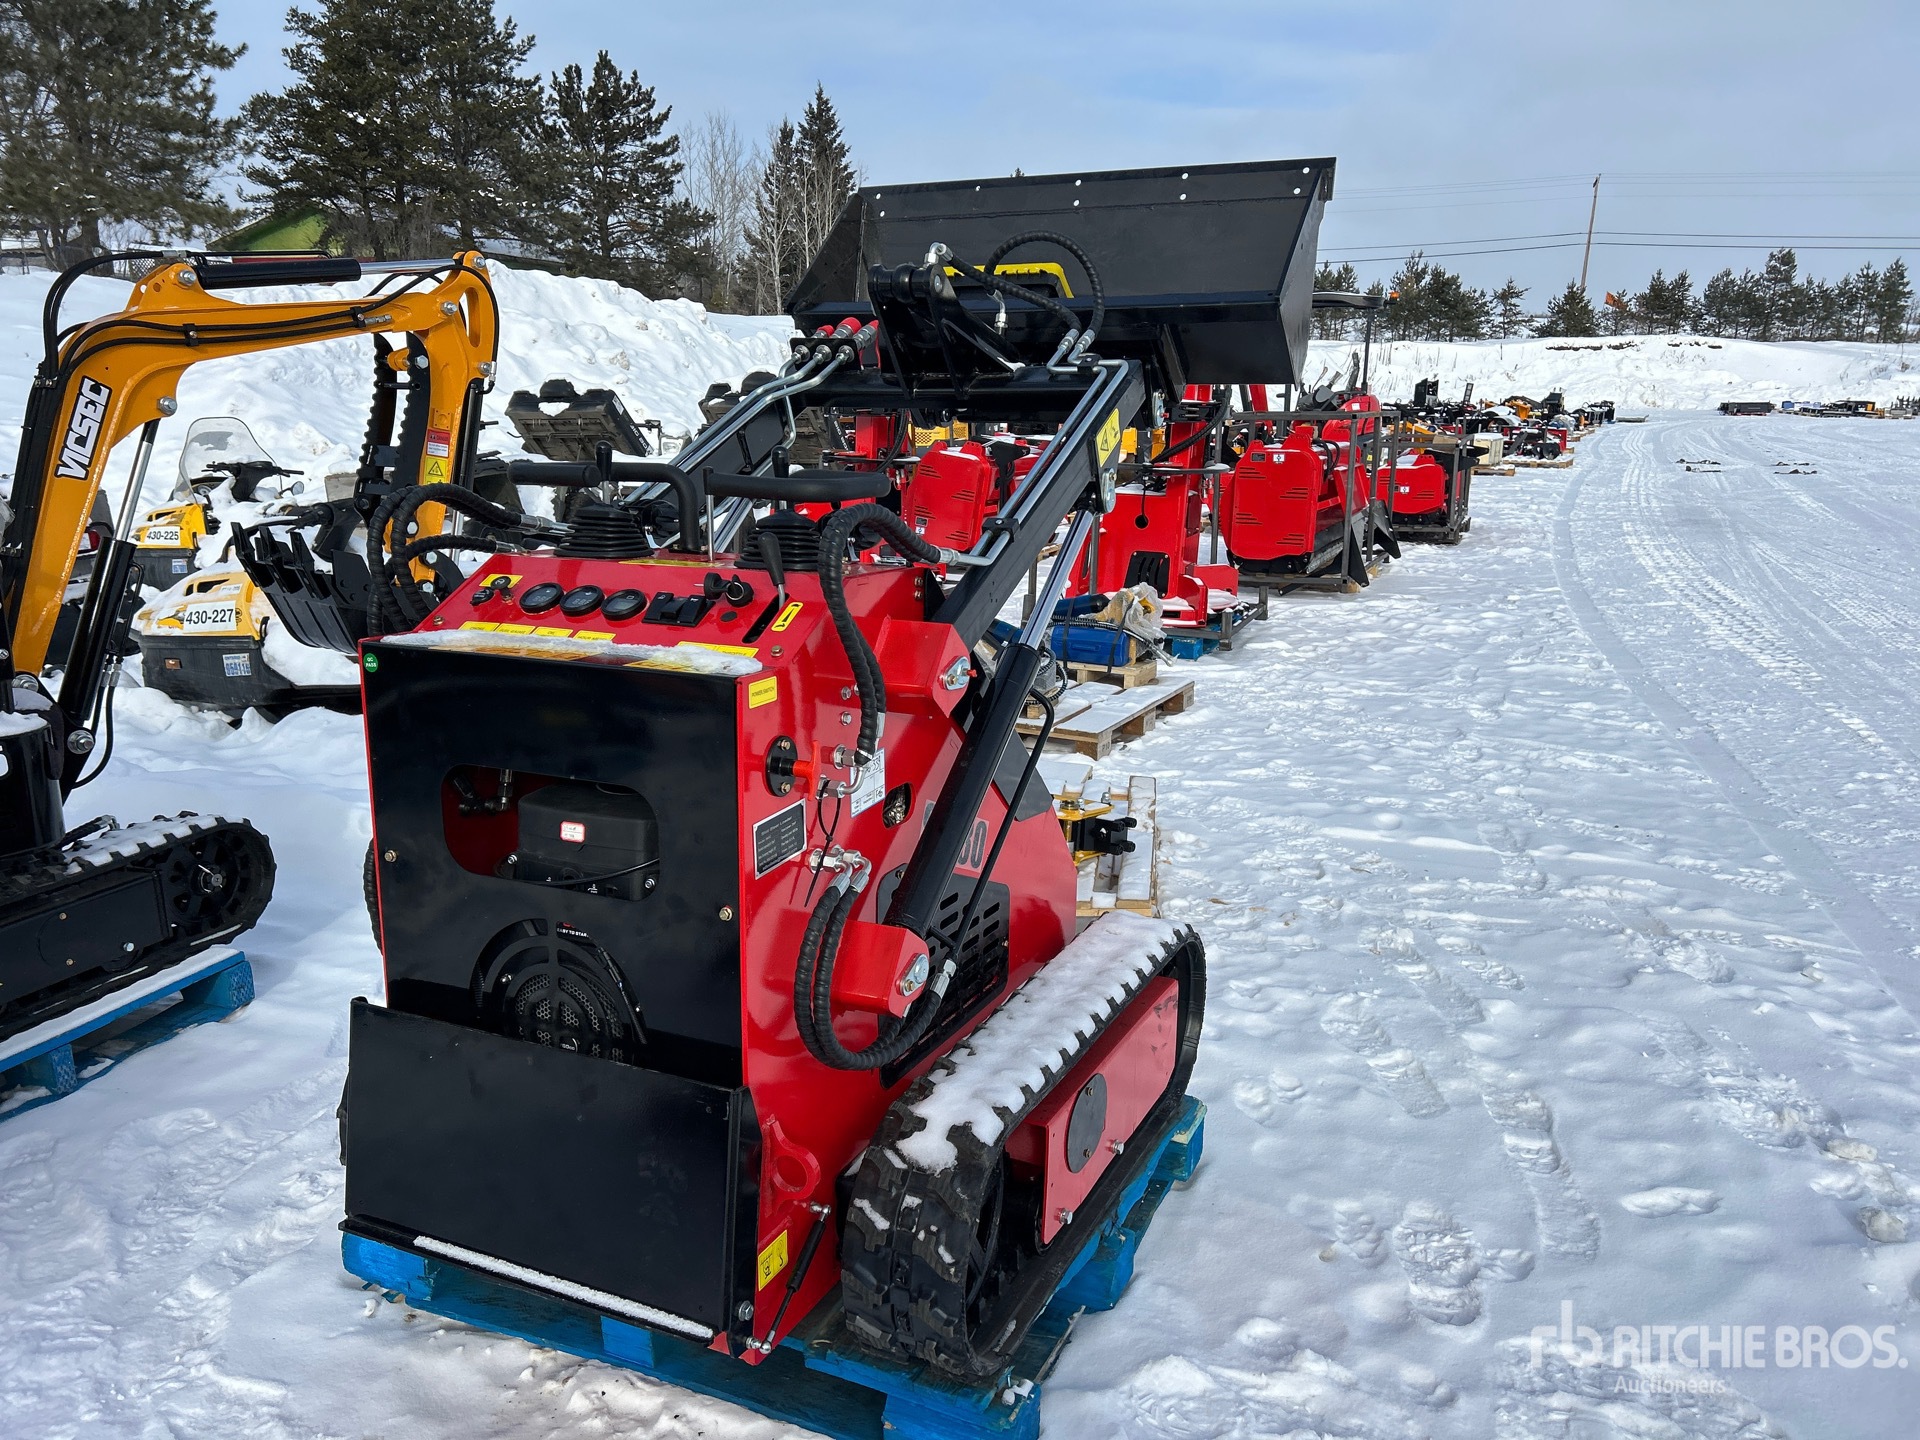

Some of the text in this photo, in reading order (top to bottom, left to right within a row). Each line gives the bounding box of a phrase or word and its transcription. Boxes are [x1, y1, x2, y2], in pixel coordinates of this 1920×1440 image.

[56, 377, 110, 479] VICSEC
[146, 530, 179, 540] 430-225
[185, 608, 234, 625] 430-227
